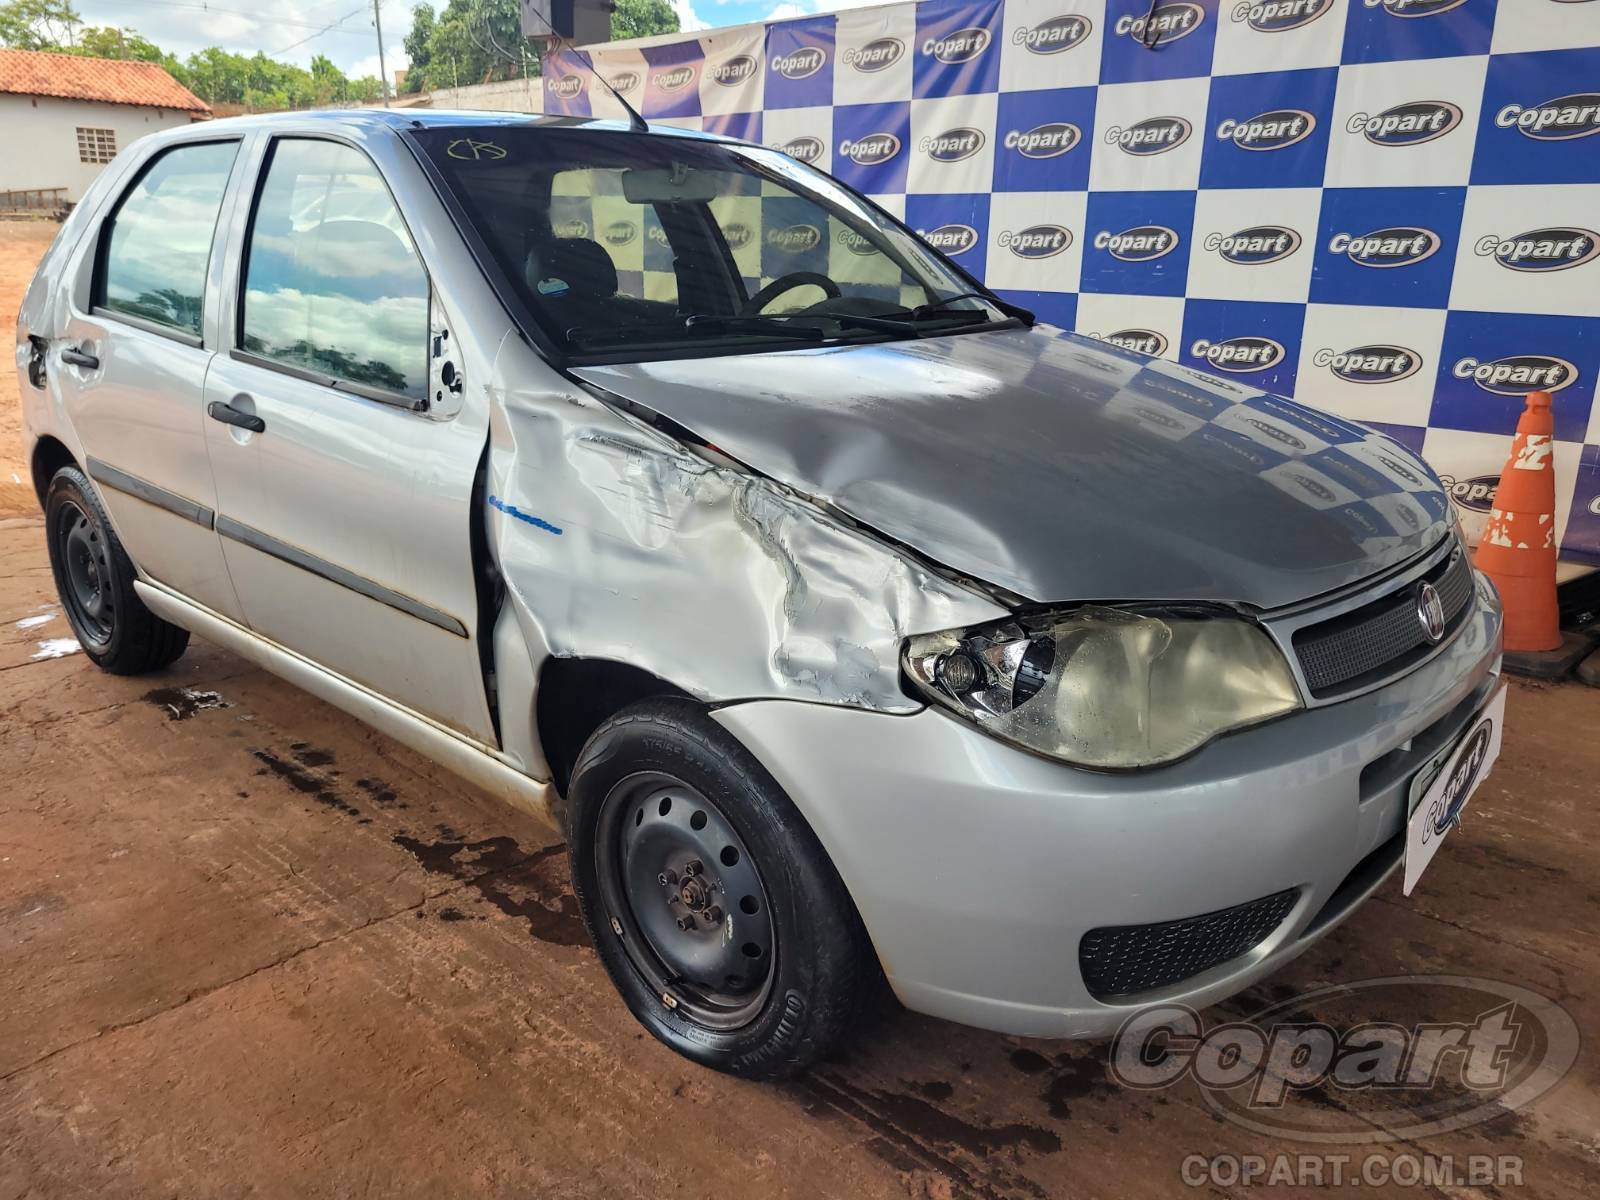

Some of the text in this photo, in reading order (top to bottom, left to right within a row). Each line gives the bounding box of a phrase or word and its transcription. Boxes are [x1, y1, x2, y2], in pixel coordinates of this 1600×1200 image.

[1231, 0, 1315, 23] Copart
[922, 34, 984, 57] Copart
[1013, 23, 1080, 47] Copart
[771, 52, 820, 73] Copart
[843, 44, 894, 67] Copart
[652, 71, 692, 88] Copart
[708, 61, 750, 81] Copart
[548, 77, 580, 94] Copart
[1104, 123, 1179, 148] Copart
[1216, 116, 1304, 141] Copart
[1346, 110, 1446, 137] Copart
[839, 139, 891, 159] Copart
[919, 134, 975, 156] Copart
[1004, 129, 1070, 153] Copart
[998, 231, 1064, 253] Copart
[1094, 231, 1168, 255] Copart
[1204, 233, 1288, 257] Copart
[1329, 232, 1425, 258] Copart
[1473, 234, 1588, 262] Copart
[1191, 339, 1273, 364] Copart
[1313, 348, 1406, 375] Copart
[1454, 358, 1562, 386] Copart
